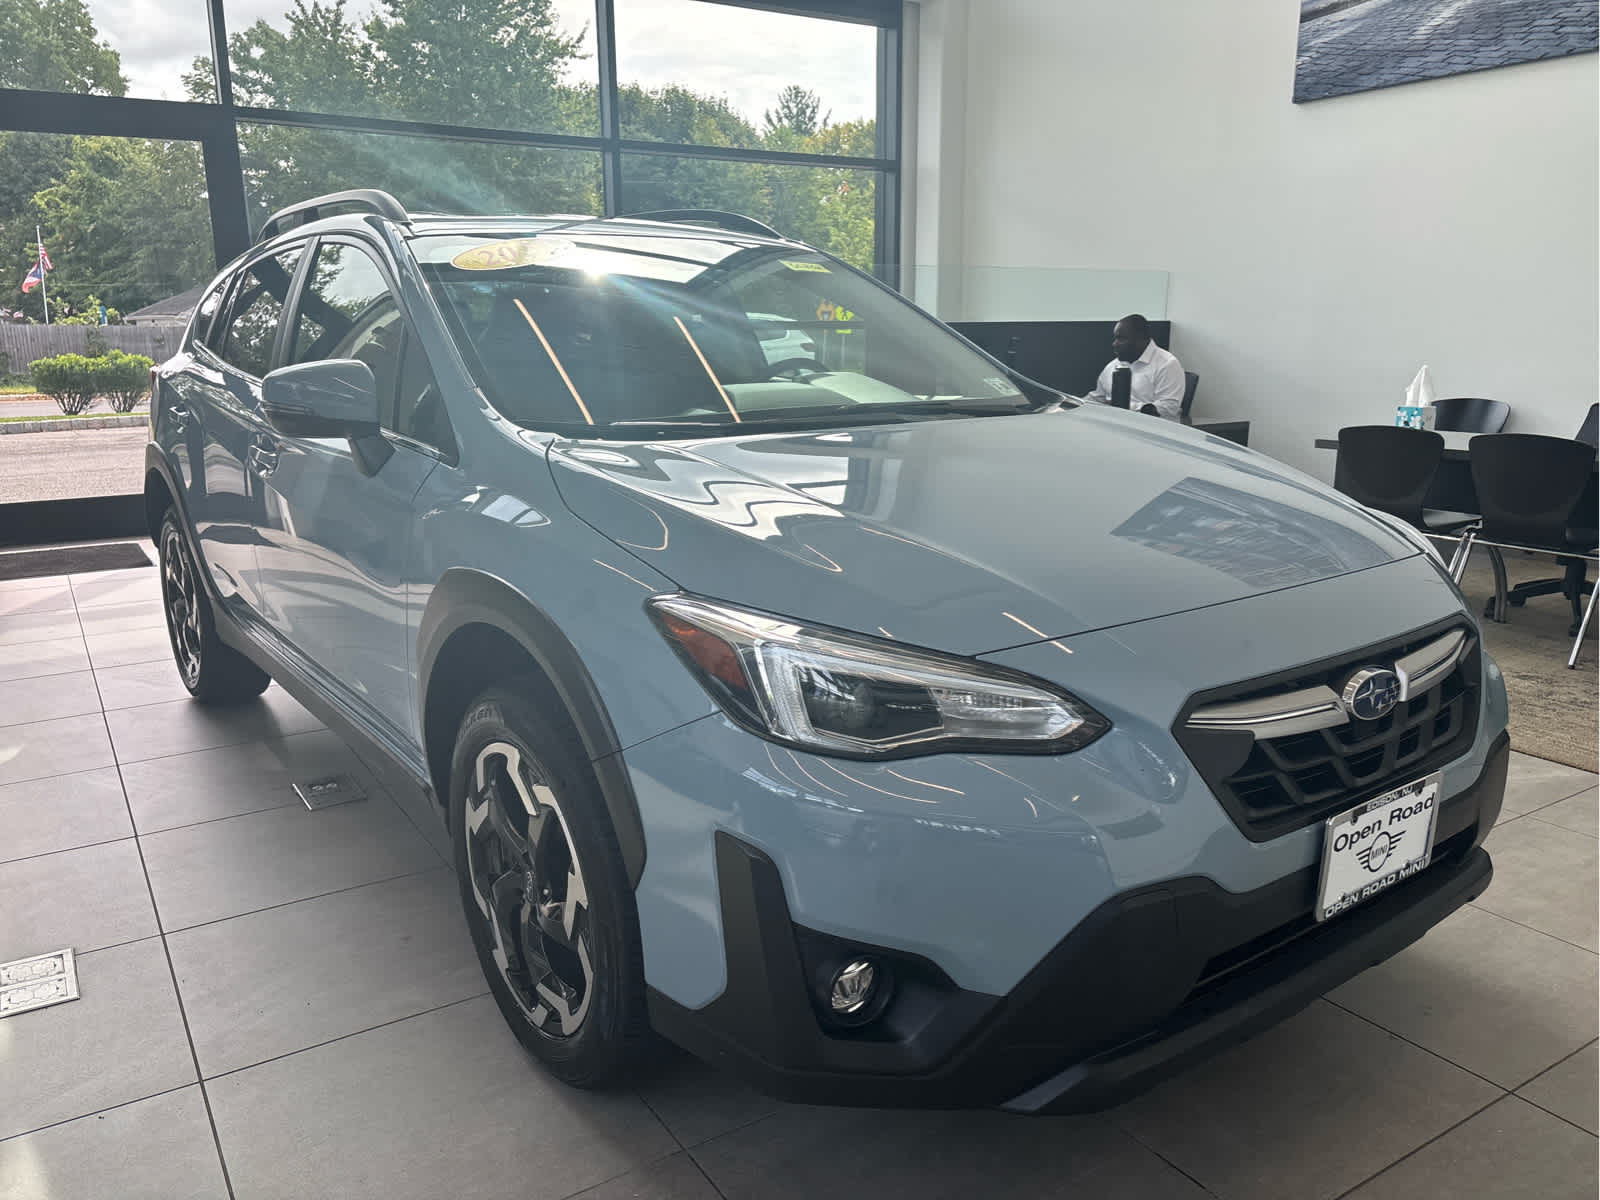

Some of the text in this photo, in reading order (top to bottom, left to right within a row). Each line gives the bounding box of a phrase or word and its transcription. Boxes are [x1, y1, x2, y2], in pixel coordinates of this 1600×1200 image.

[1334, 792, 1435, 852] Open Road
[1371, 844, 1388, 860] MINI
[1325, 859, 1426, 918] OPEN ROAD MINI
